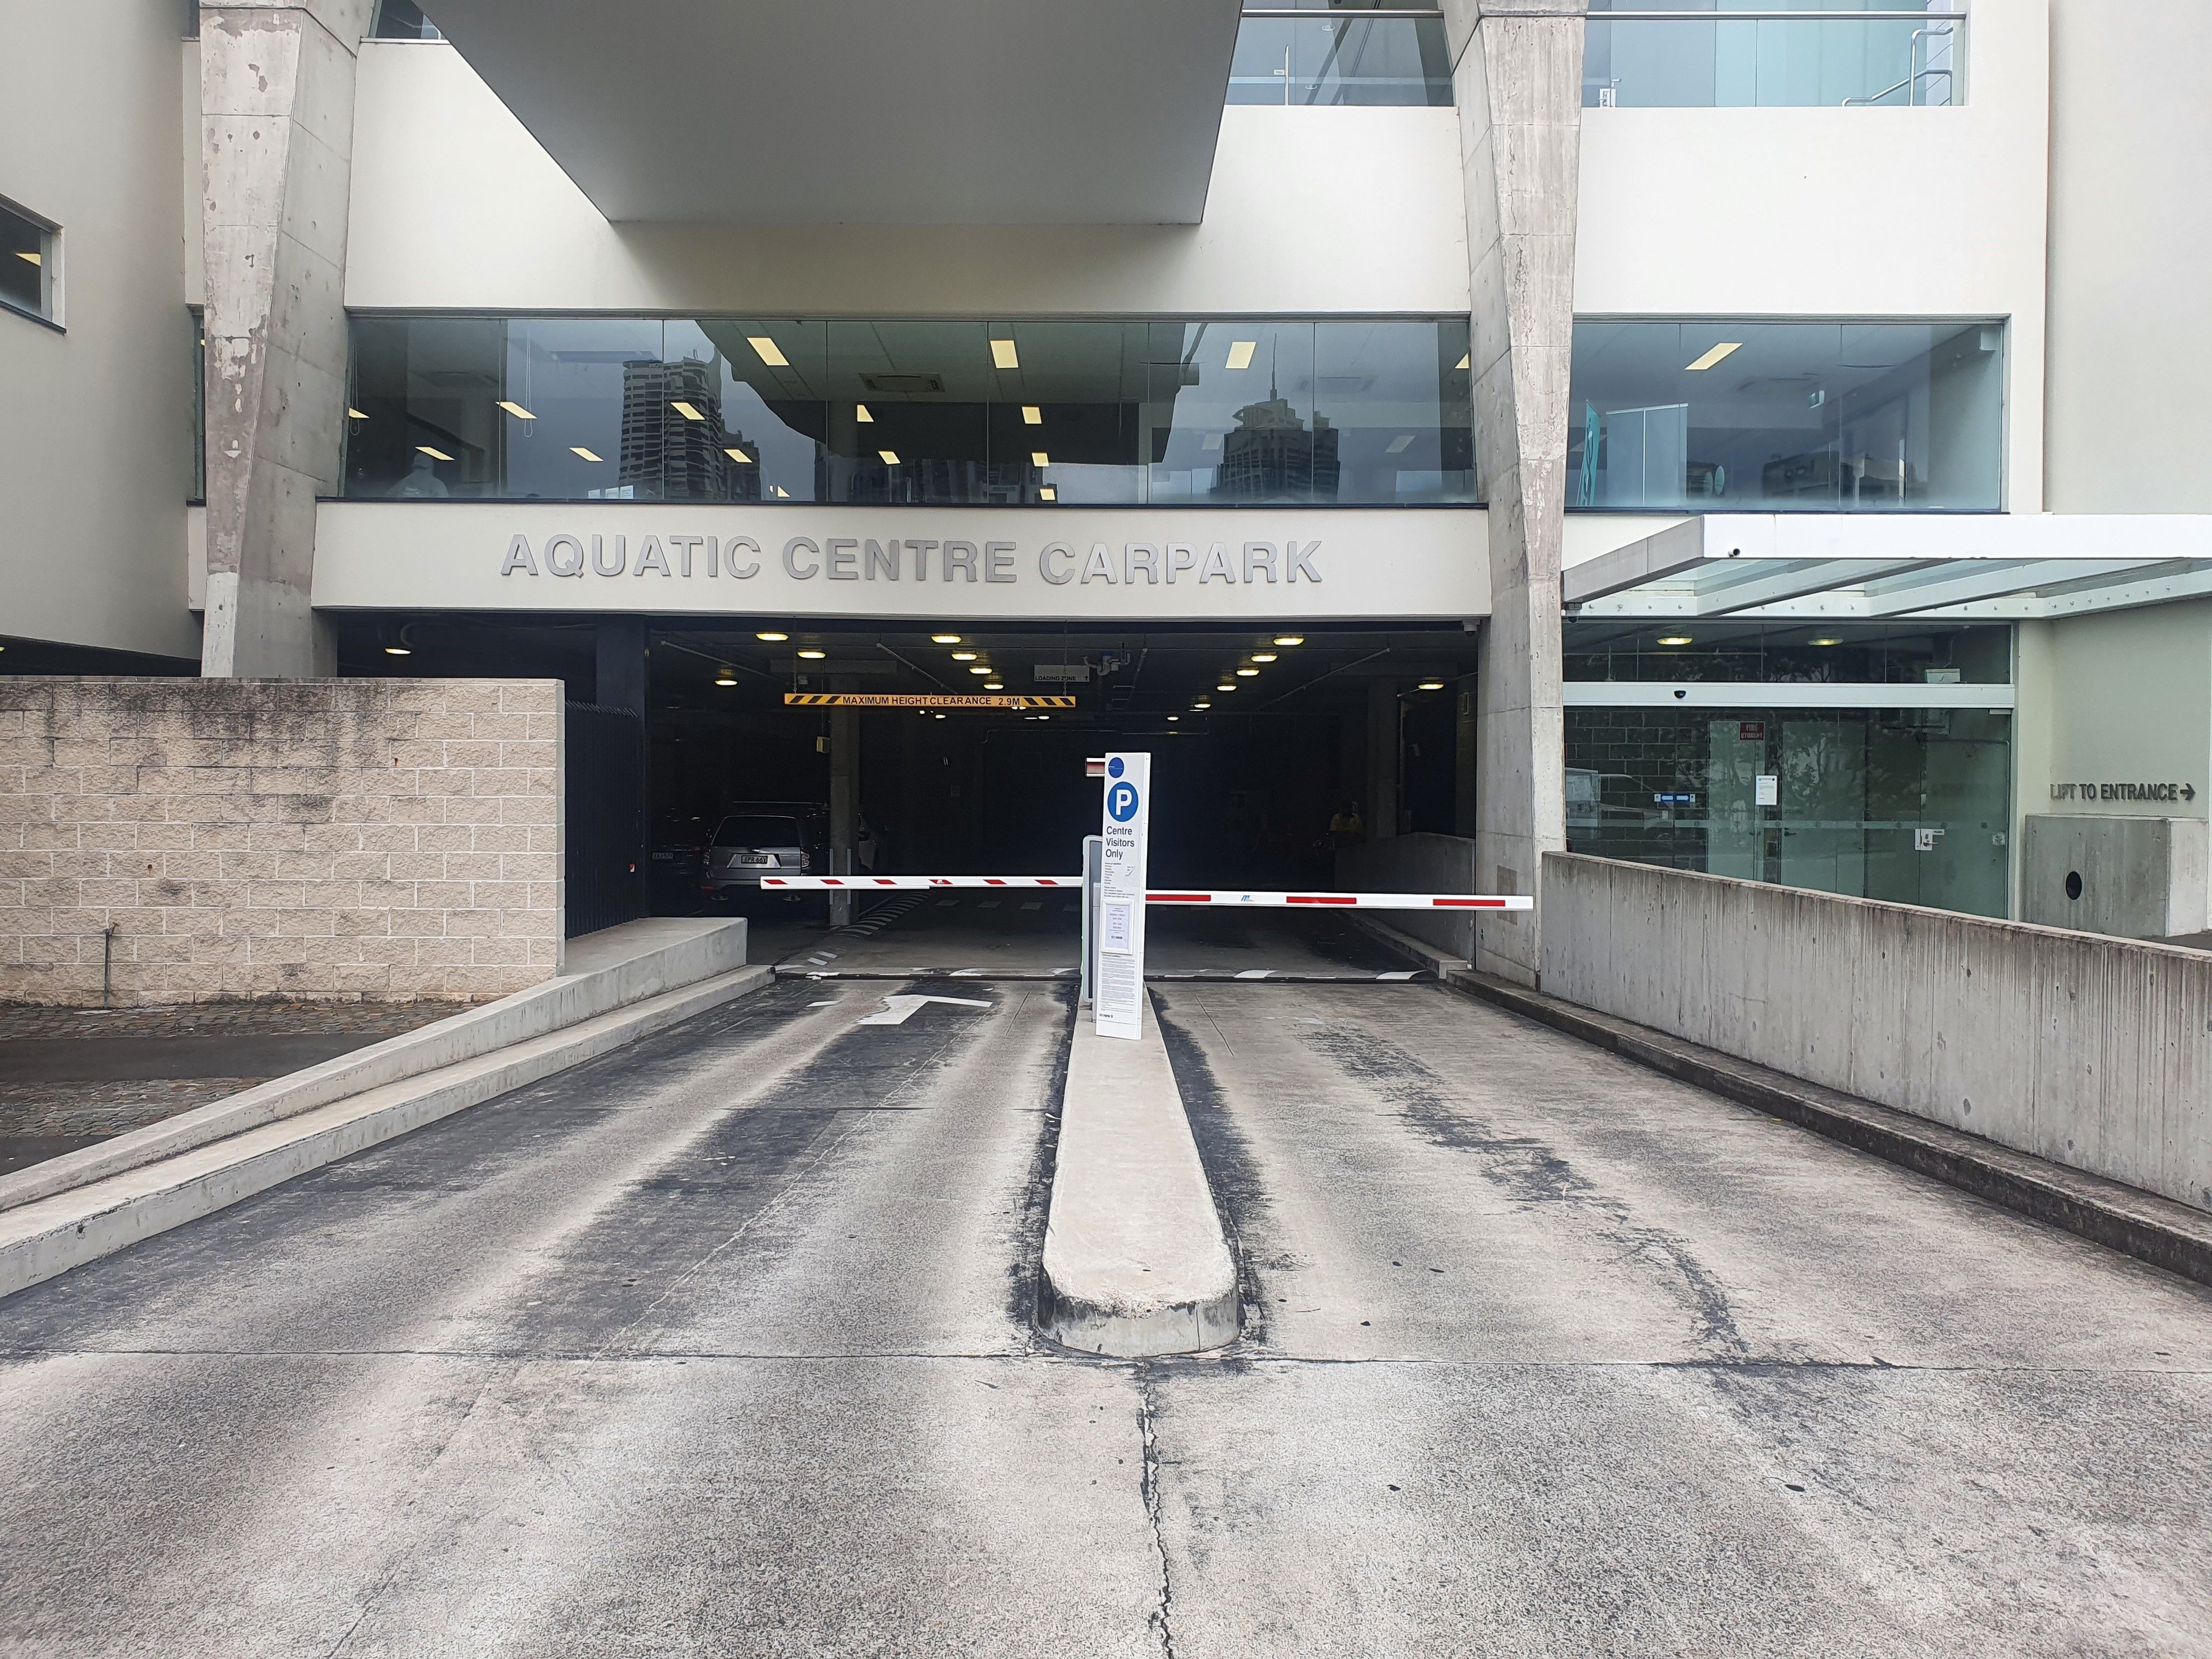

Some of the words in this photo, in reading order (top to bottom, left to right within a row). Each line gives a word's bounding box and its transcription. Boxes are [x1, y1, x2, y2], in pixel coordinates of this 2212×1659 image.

[501, 533, 761, 578] AQUATIC
[782, 536, 1017, 582] CENTRE
[1039, 540, 1323, 585] CARPARK
[843, 696, 889, 704] MAXIMUM
[892, 696, 928, 704] HEIGHT
[930, 697, 991, 705] CLEARANCE
[998, 698, 1020, 706] 2.9M
[2050, 783, 2077, 800] LIFT
[2079, 783, 2096, 800] TO
[2101, 783, 2177, 801] ENTRANCE
[1116, 789, 1132, 815] P
[1106, 825, 1132, 835] Centre
[1105, 838, 1135, 847] Visitors
[1105, 849, 1123, 860] Only
